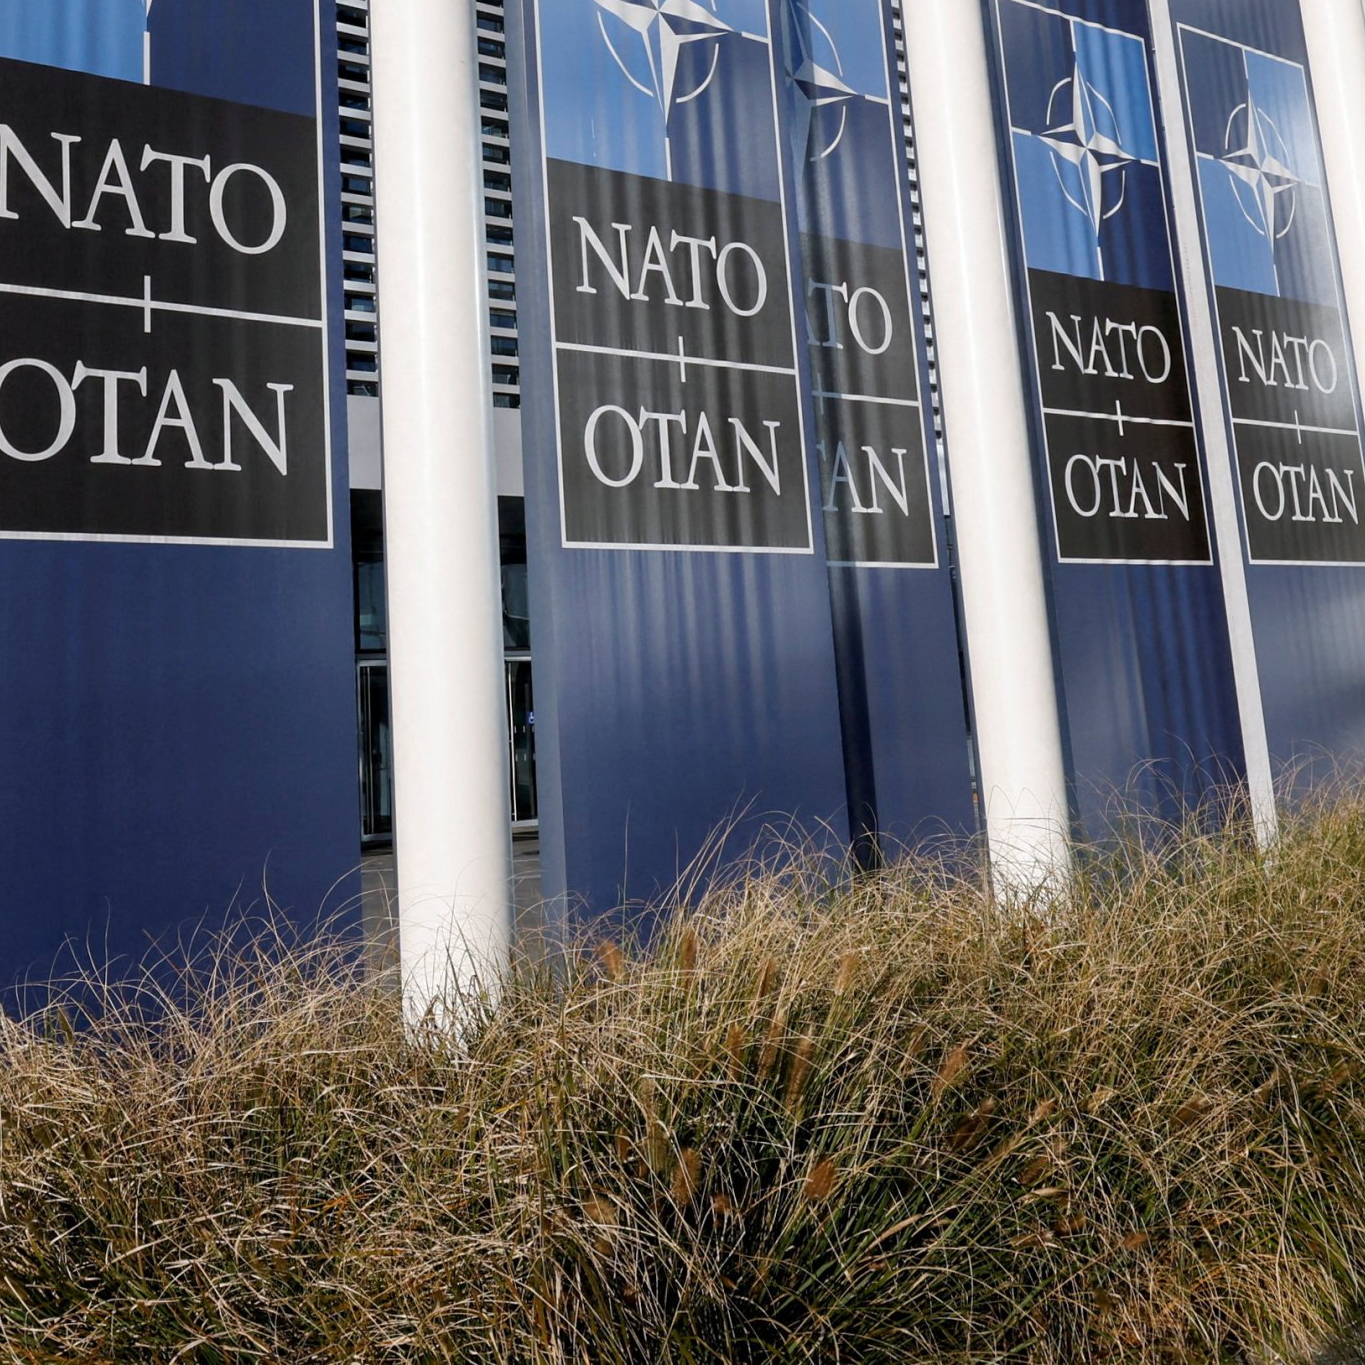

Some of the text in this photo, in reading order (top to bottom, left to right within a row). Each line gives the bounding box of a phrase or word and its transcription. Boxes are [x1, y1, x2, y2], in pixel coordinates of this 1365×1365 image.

[573, 216, 767, 316] NATO
[805, 278, 893, 355] TO
[1046, 312, 1170, 383] NATO
[1232, 326, 1336, 394] NATO
[584, 405, 780, 495] OTAN
[816, 439, 909, 517] AN
[1065, 455, 1189, 520] OTAN
[1253, 462, 1358, 524] OTAN
